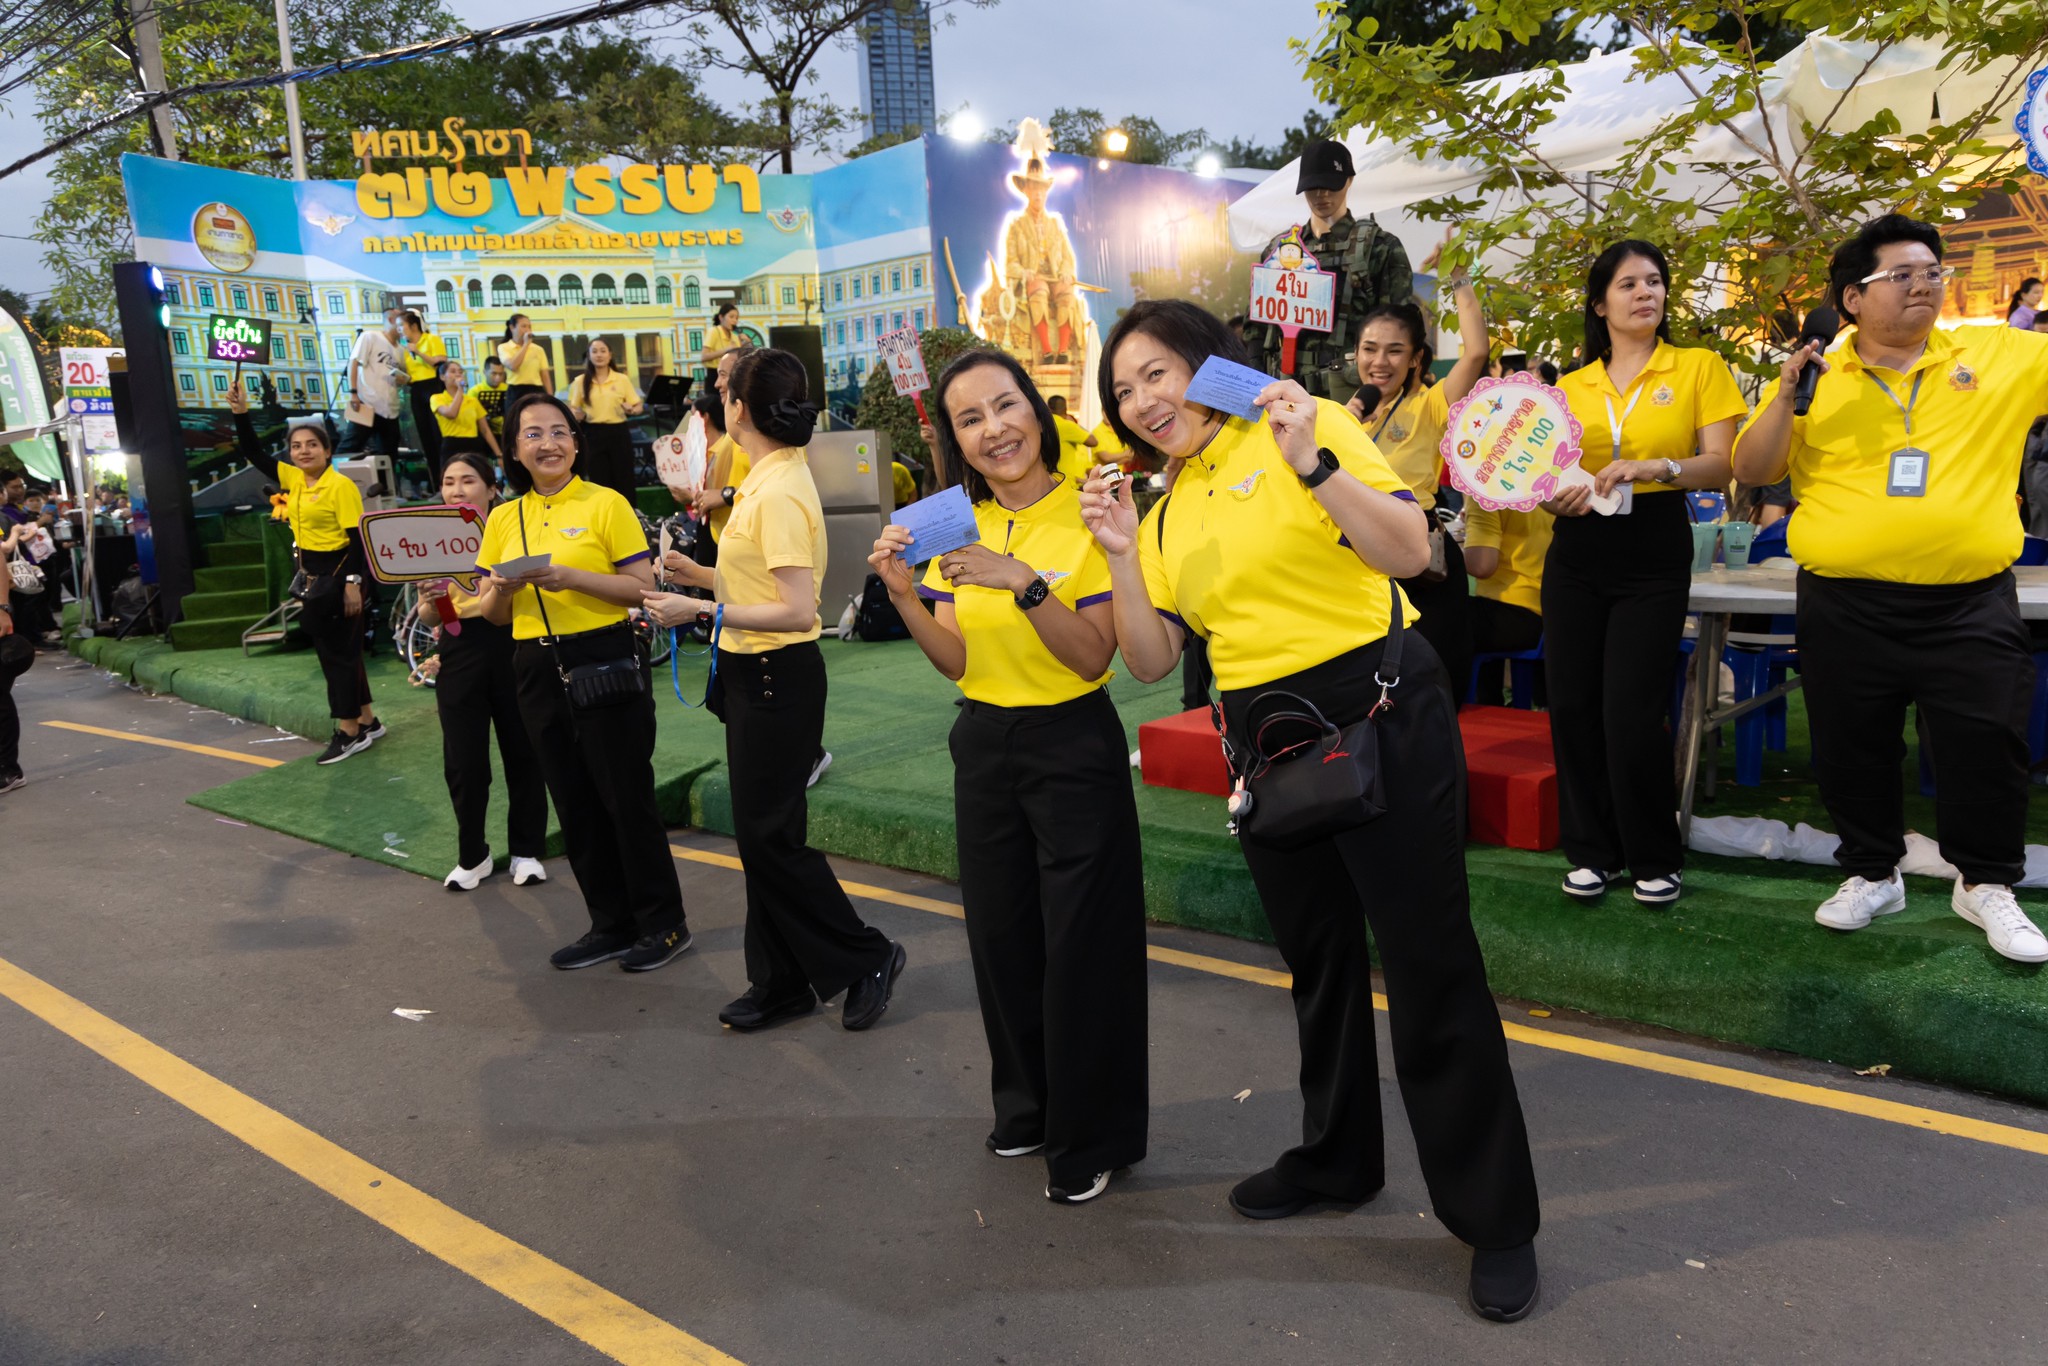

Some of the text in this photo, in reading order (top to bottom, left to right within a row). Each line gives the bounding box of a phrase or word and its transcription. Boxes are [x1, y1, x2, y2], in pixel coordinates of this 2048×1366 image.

[351, 117, 533, 163] ทศมราชา
[356, 163, 762, 219] ๗๒ พรรษา
[1255, 296, 1327, 327] 100 บาท
[213, 318, 262, 345] ยิงปืน
[894, 372, 926, 391] 100 บาท
[1474, 397, 1537, 485] สลากกาชาด
[1500, 417, 1555, 491] 4 ใบ 100
[380, 536, 480, 560] 4 ใบ 100
